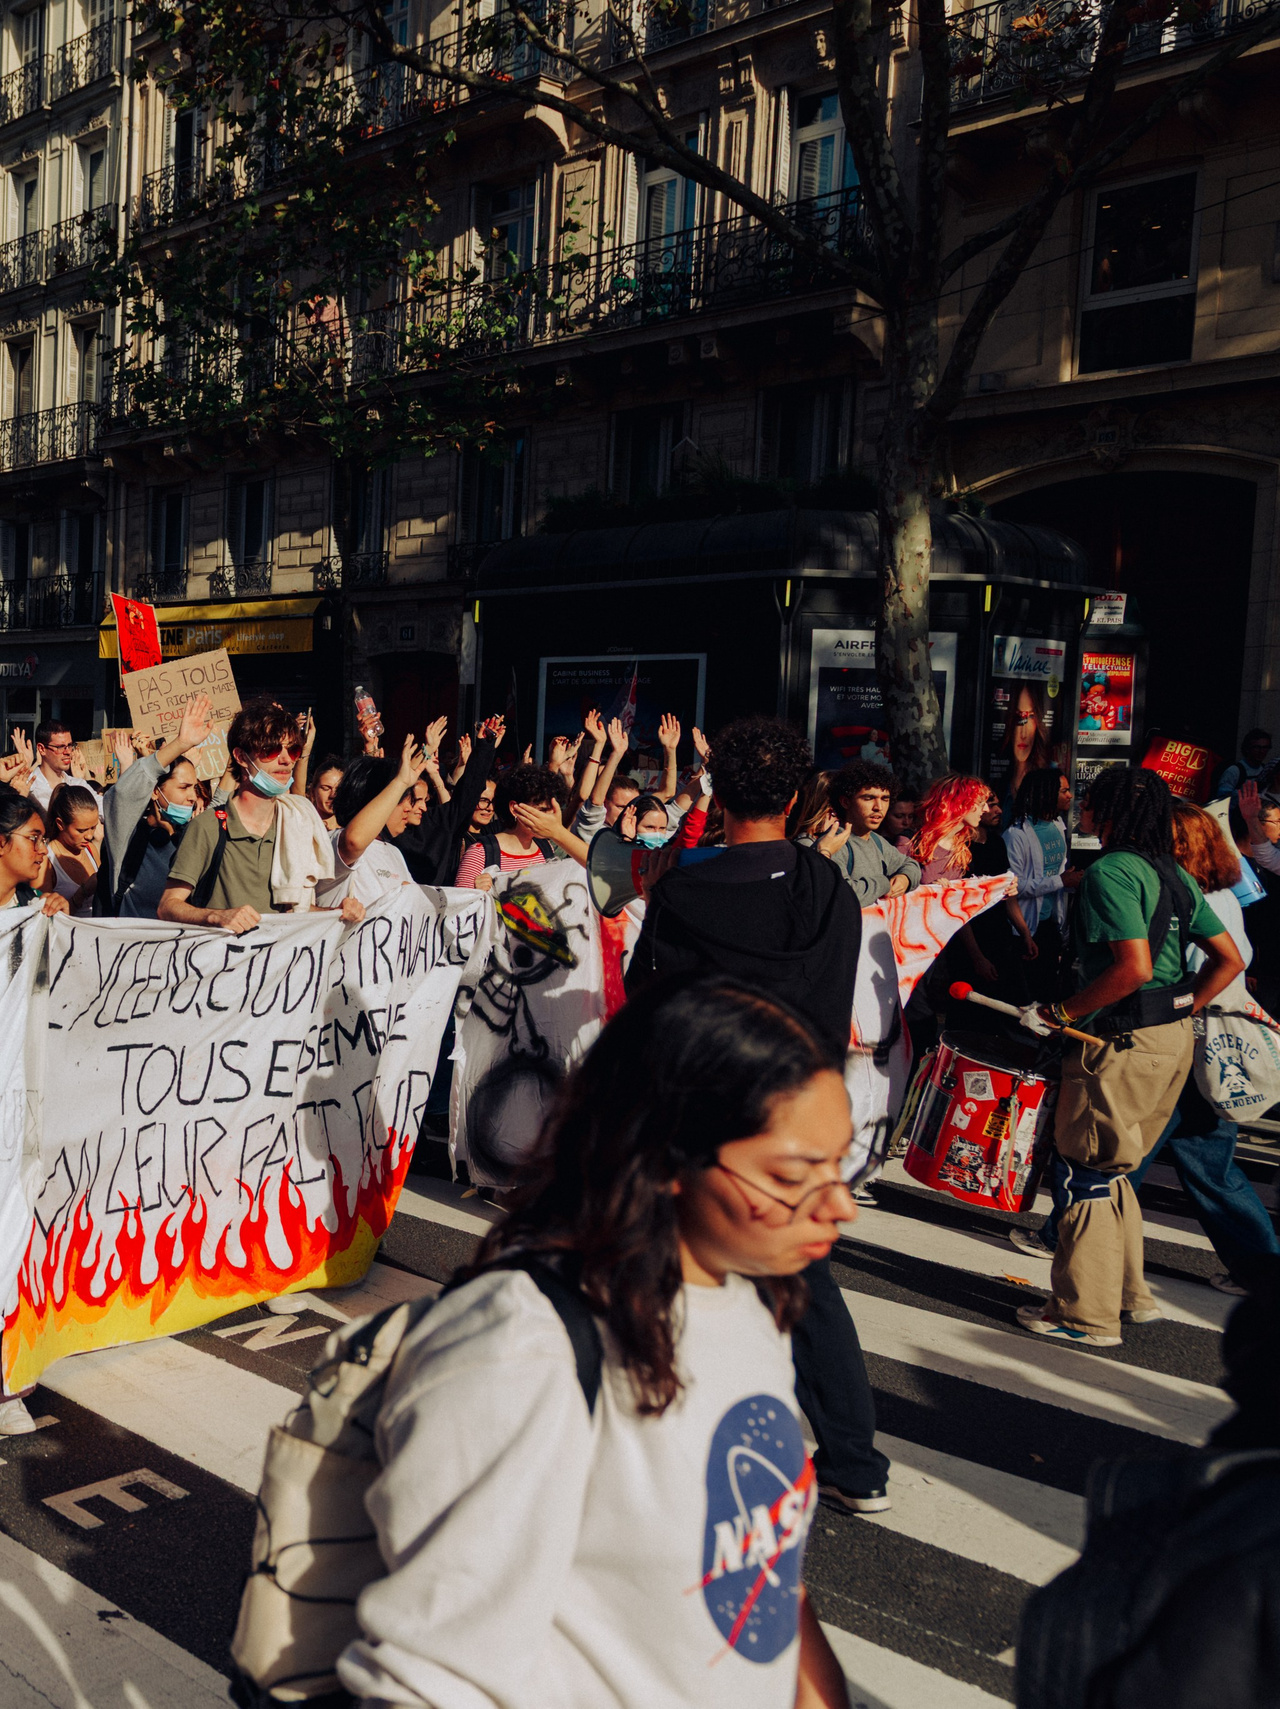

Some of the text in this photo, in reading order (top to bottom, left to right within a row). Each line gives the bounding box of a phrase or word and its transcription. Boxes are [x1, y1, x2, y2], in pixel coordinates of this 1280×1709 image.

[186, 626, 223, 645] Paris
[268, 631, 285, 641] shop
[138, 660, 230, 703] PAS TOUS
[552, 669, 610, 678] CABINE BUSINESS
[139, 700, 161, 716] LES
[152, 722, 178, 736] LES
[1165, 741, 1192, 757] BIG
[1161, 752, 1188, 767] BUS
[1156, 769, 1196, 787] OFFICIAL
[1169, 784, 1196, 798] ELLER
[1204, 1033, 1259, 1065] HYSTERIC
[107, 1042, 249, 1116] TOUS
[1233, 1099, 1245, 1108] NO
[106, 1116, 228, 1215] LEUR
